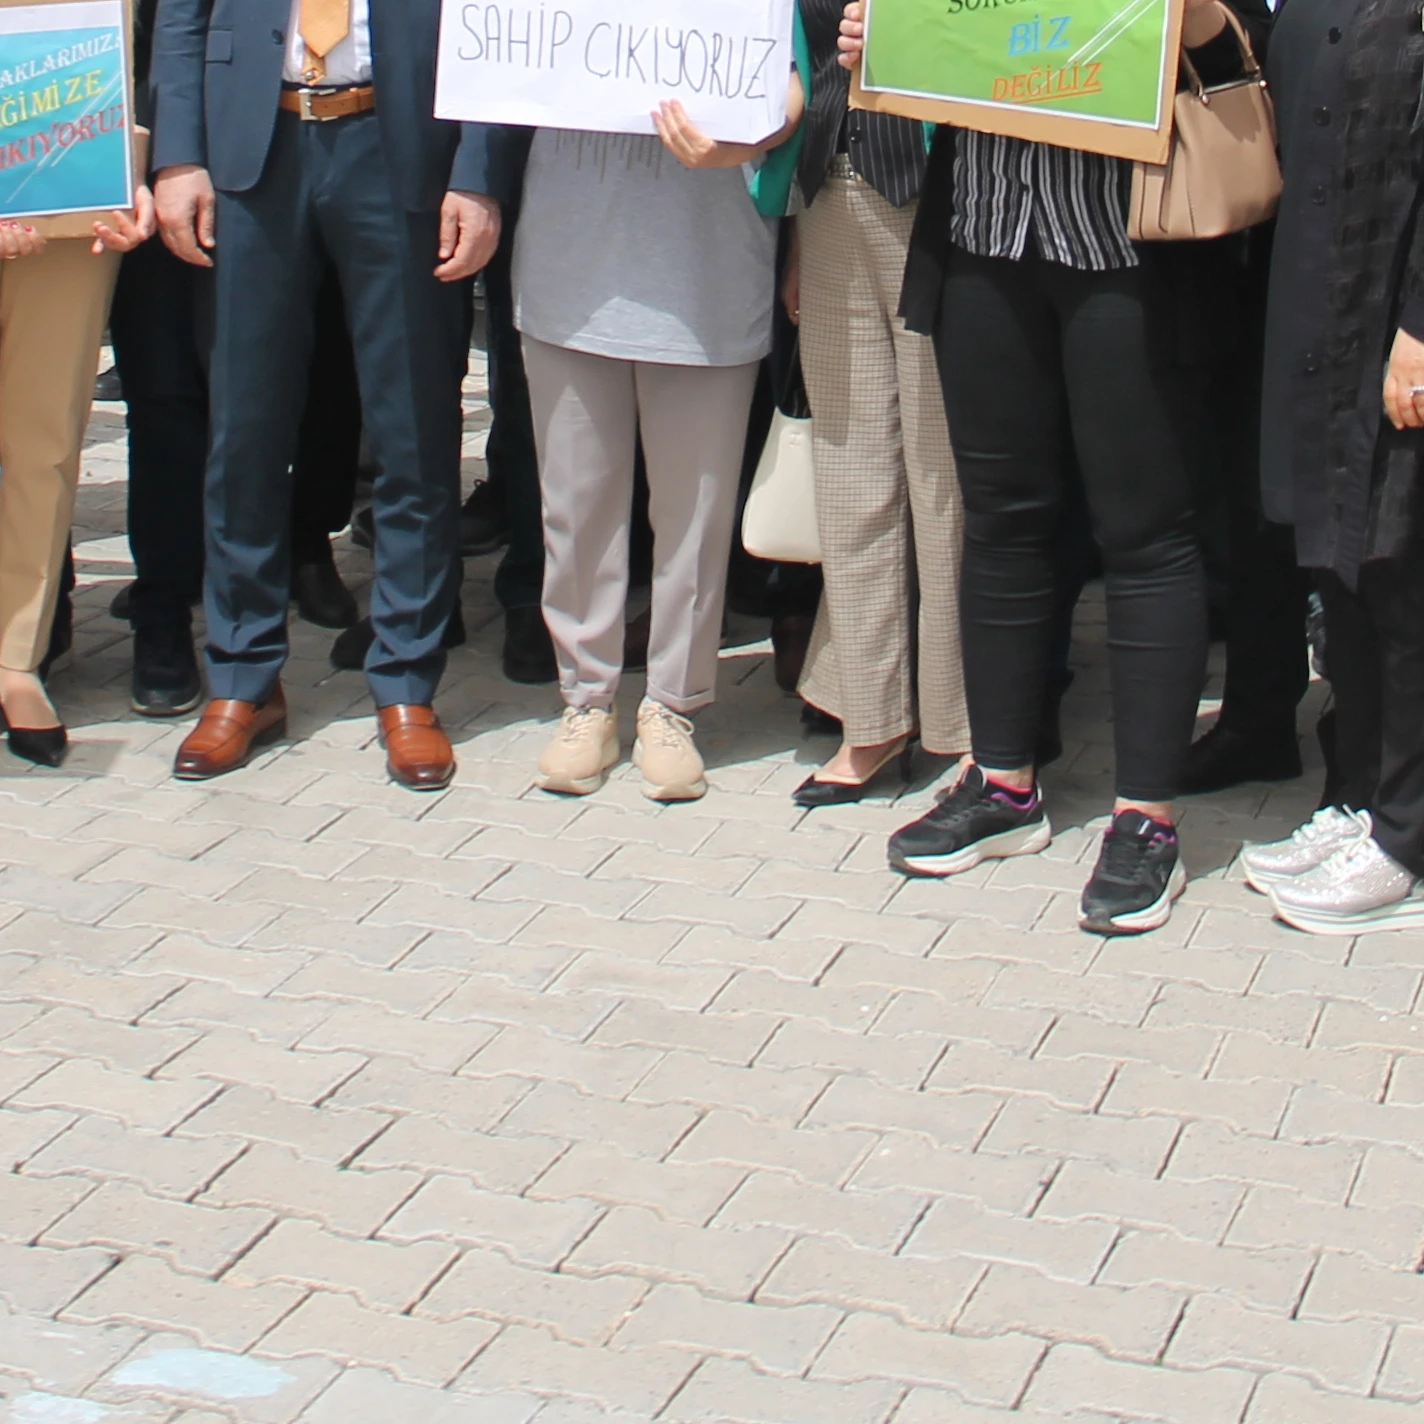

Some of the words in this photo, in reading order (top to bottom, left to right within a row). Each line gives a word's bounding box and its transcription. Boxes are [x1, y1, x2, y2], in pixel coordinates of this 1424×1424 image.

[457, 2, 573, 70] SAHİP
[1008, 13, 1073, 57] BİZ
[991, 62, 1104, 103] DEĞİLİZ
